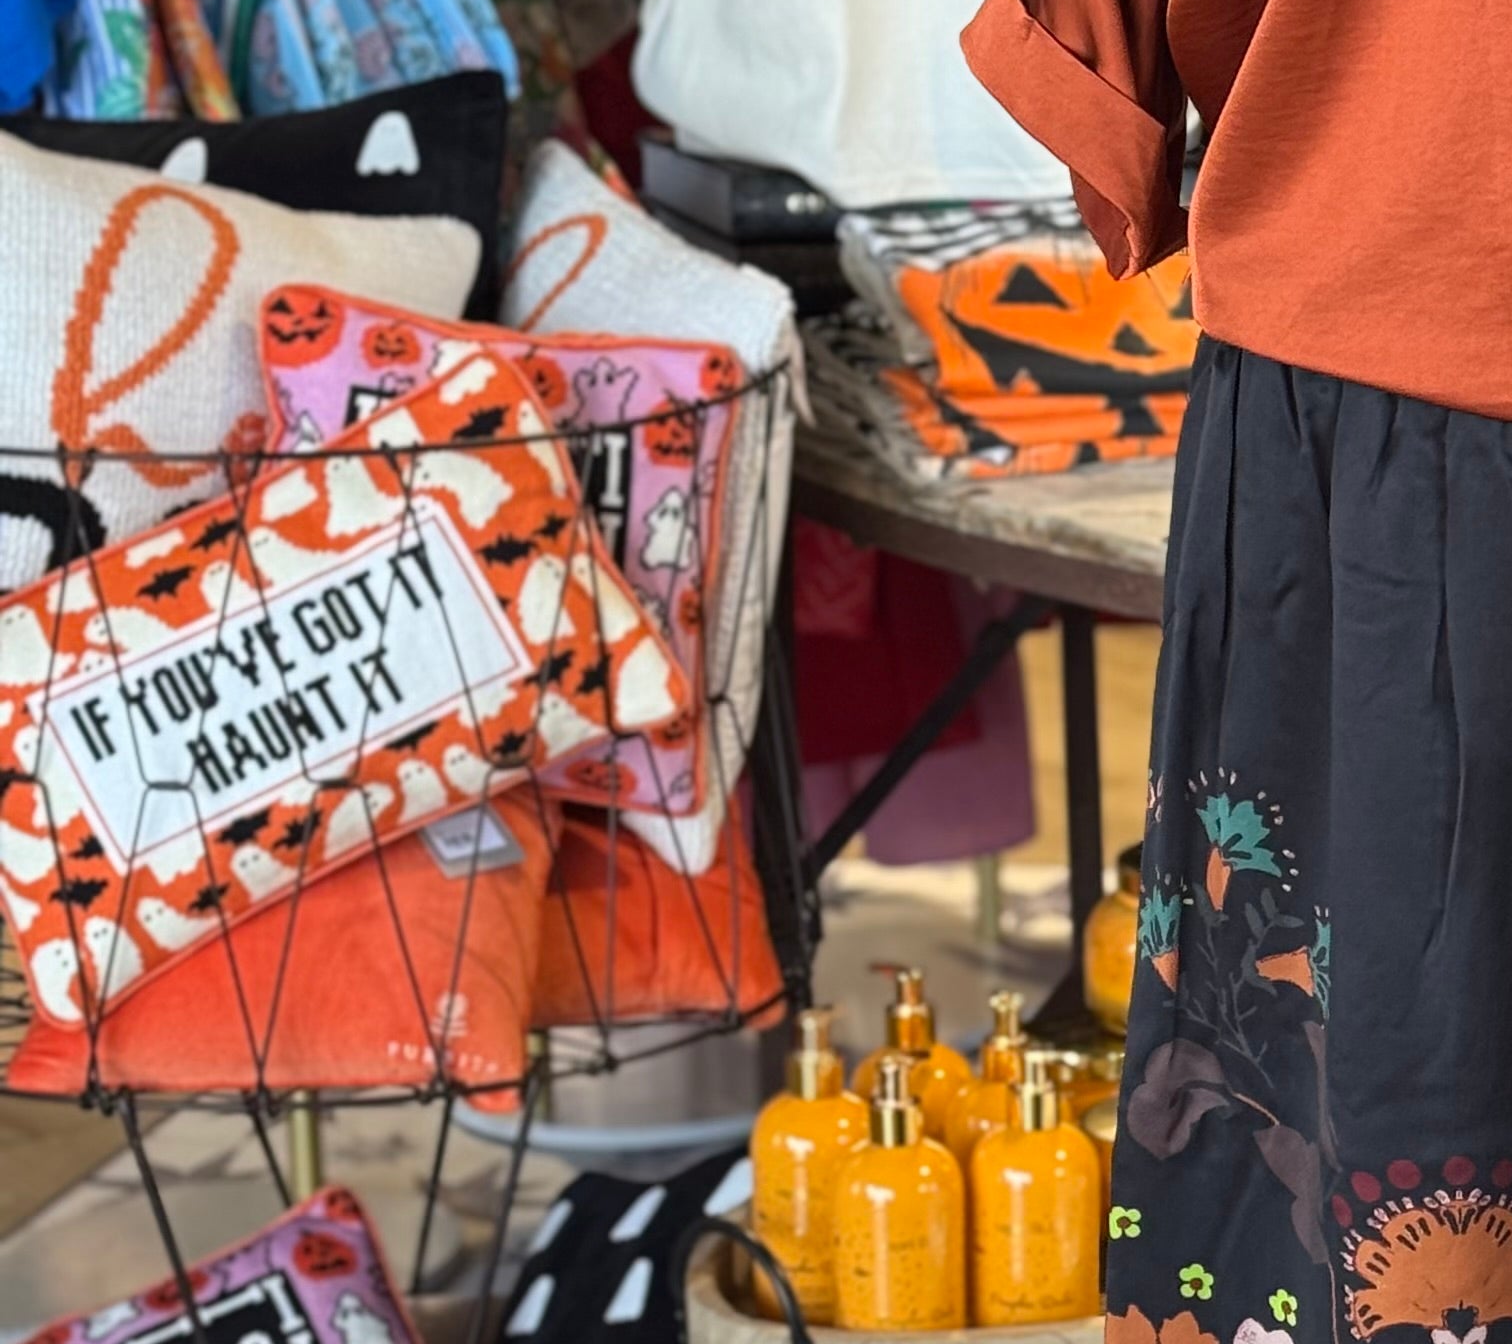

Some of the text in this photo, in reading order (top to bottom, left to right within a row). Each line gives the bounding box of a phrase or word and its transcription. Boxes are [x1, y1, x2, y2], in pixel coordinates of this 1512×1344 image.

[70, 540, 444, 763] IF YOU'VE GOT IT
[186, 646, 405, 795] HAUNT IT
